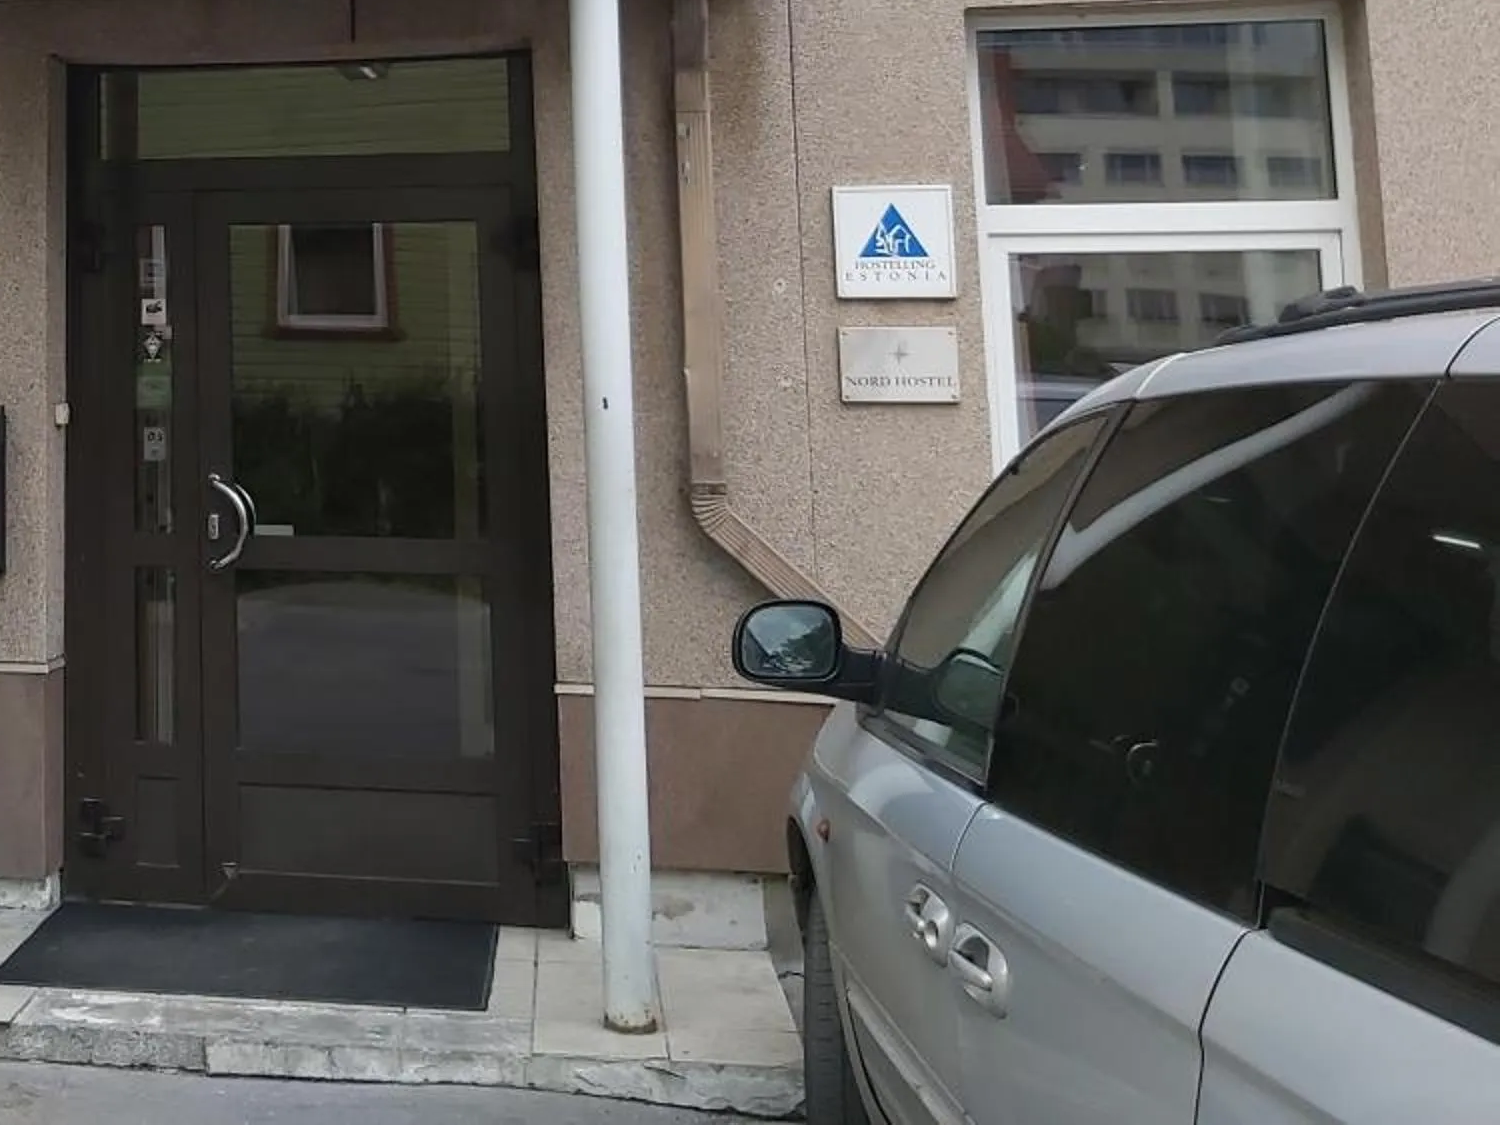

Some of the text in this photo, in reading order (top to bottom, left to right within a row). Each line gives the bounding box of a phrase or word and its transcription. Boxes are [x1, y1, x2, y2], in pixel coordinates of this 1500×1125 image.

[855, 260, 936, 270] HOSTELLING
[845, 272, 947, 282] ESTONIA
[845, 376, 955, 387] NORD HOSTEL
